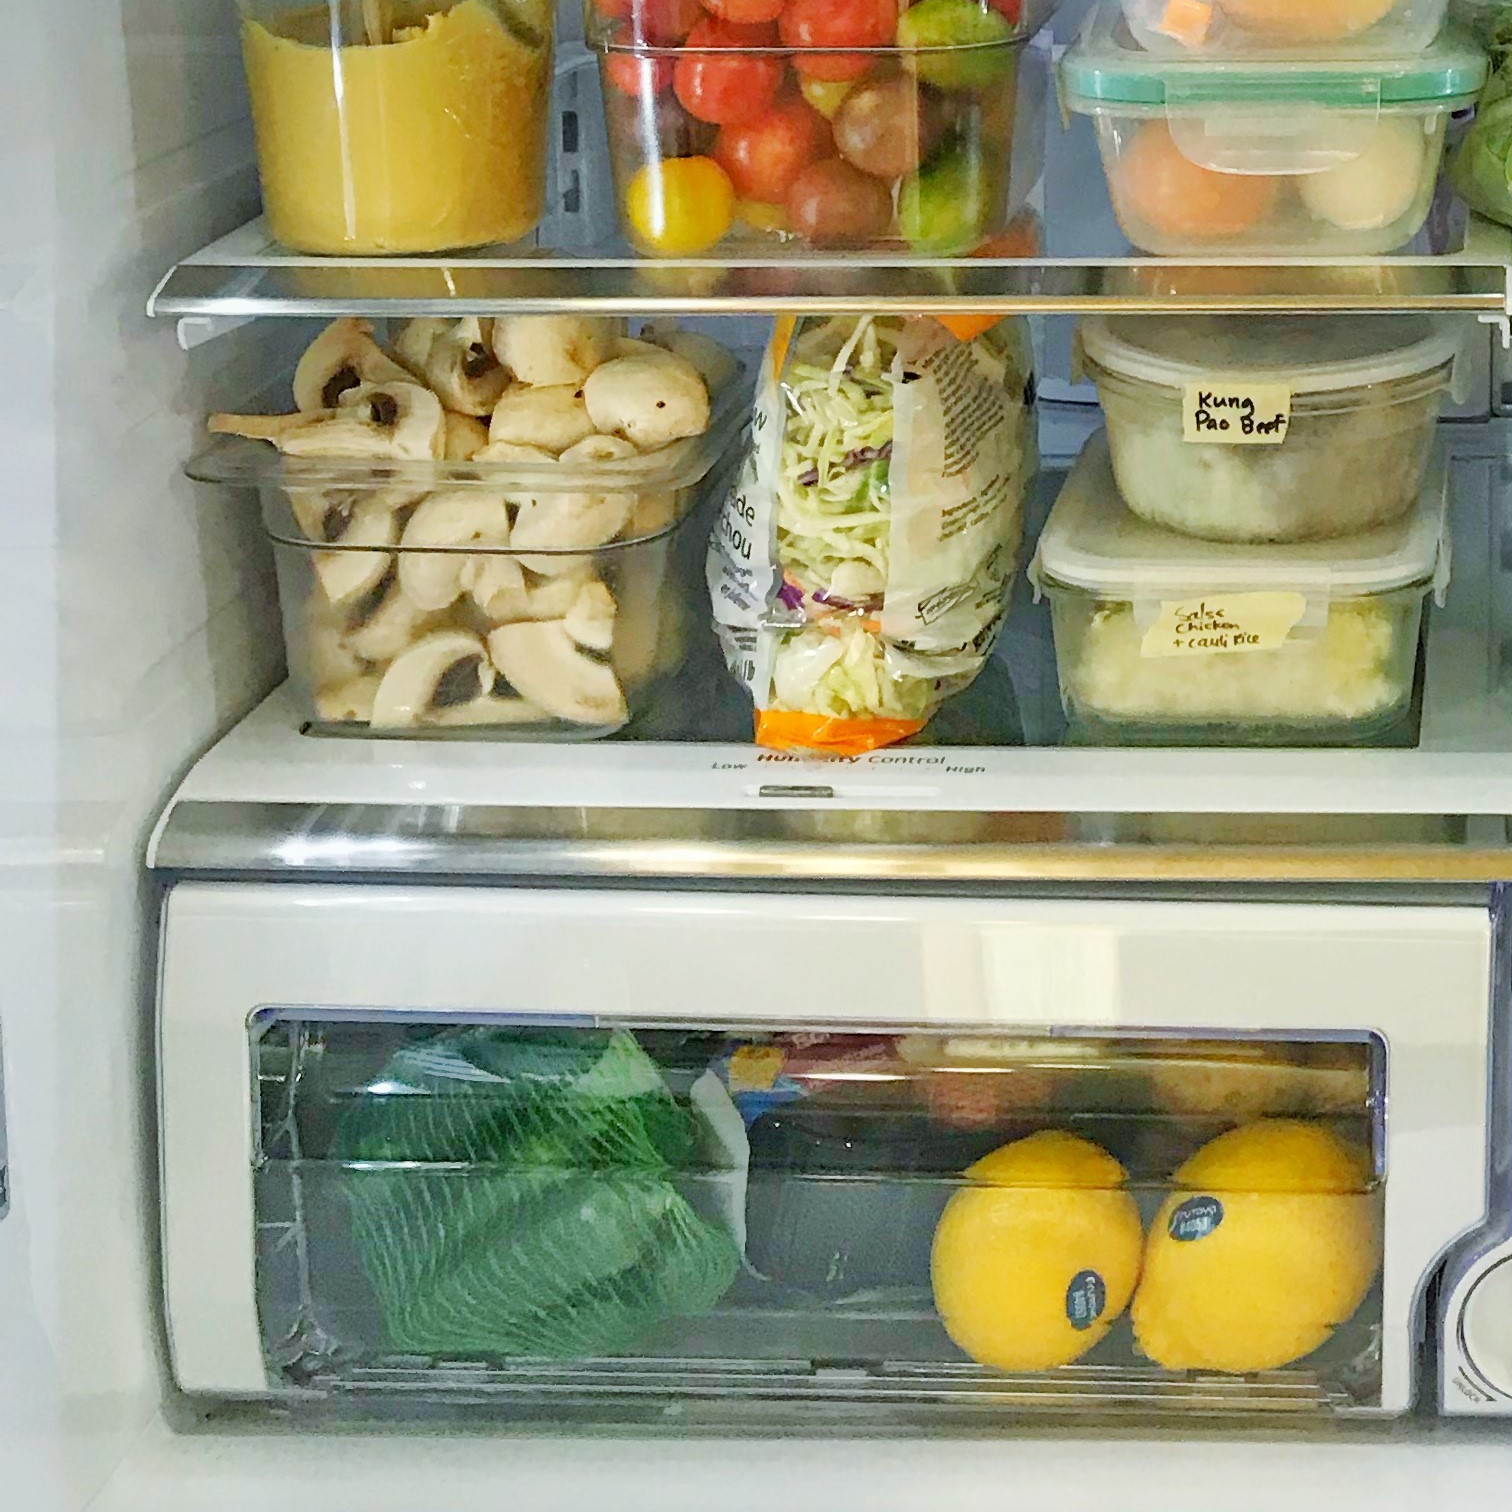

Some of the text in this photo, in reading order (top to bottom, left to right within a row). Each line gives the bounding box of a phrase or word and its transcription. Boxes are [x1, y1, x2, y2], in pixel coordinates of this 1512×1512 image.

[1198, 391, 1255, 418] Kung
[1195, 409, 1231, 432] Pao
[868, 755, 946, 765] Control
[711, 761, 747, 770] Low
[946, 765, 985, 774] High
